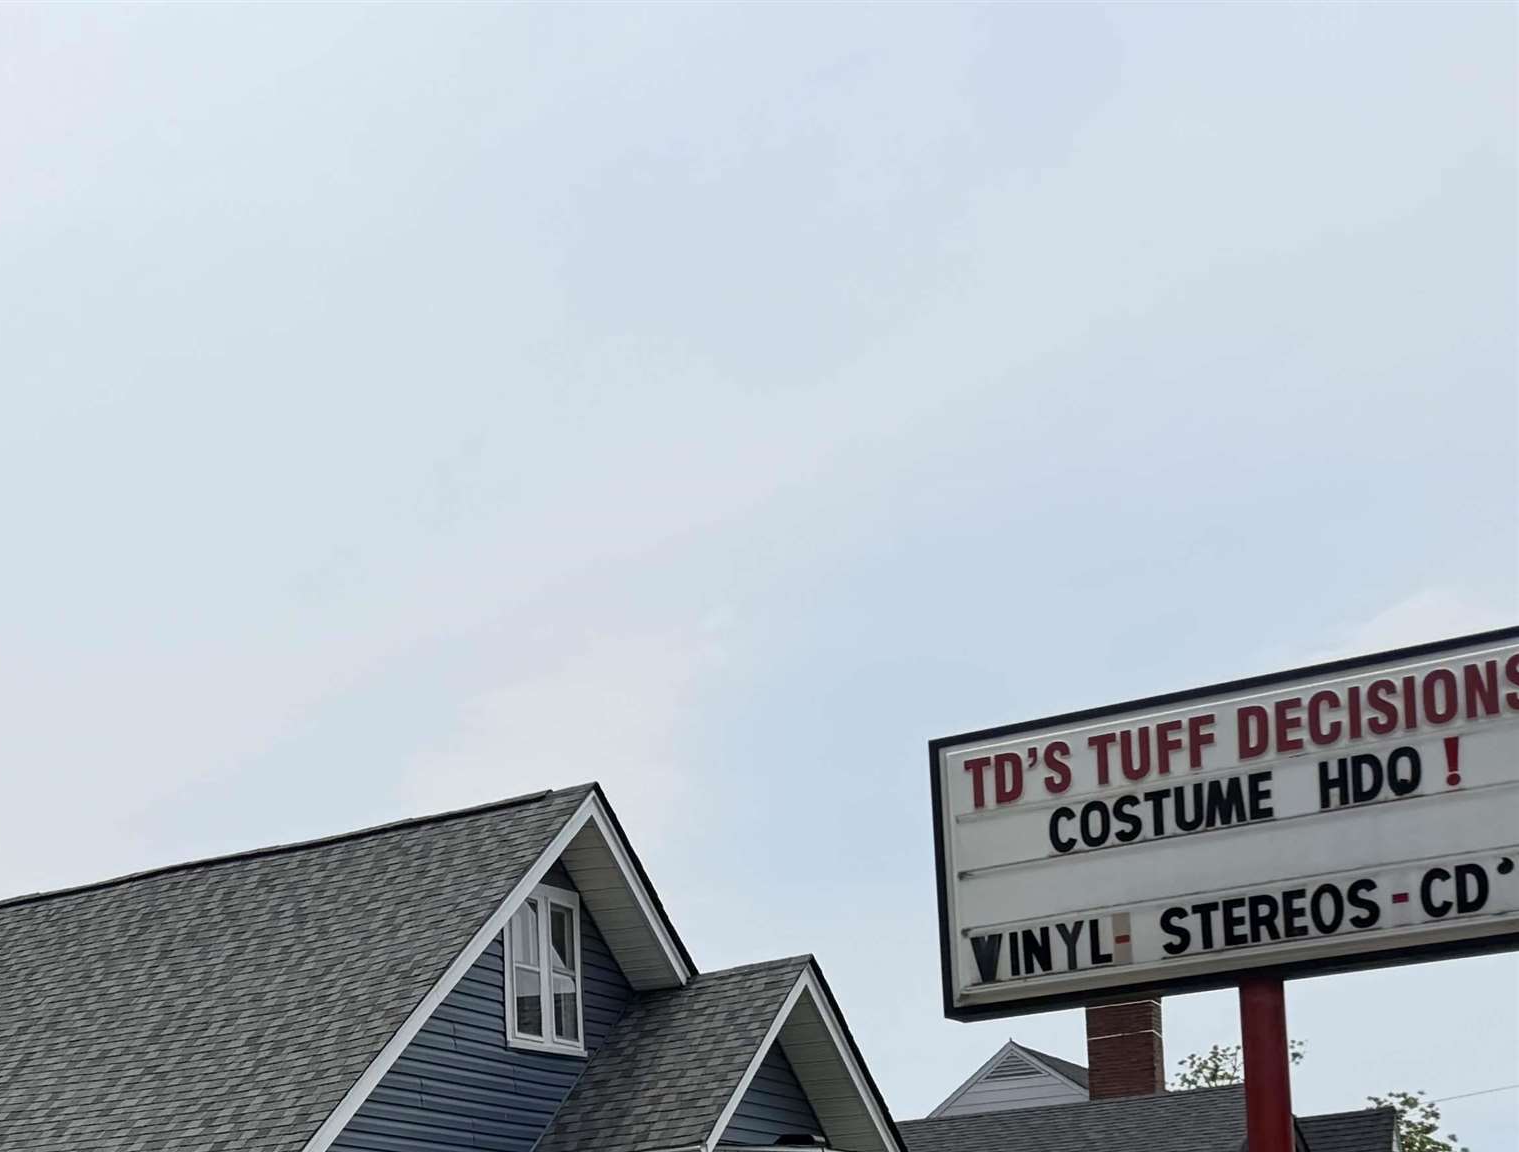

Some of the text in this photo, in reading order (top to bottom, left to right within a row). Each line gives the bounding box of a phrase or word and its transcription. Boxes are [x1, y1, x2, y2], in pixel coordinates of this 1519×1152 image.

[964, 741, 1072, 808] TD'S
[1088, 714, 1215, 785] TUFF
[1050, 770, 1275, 854] COSTUME
